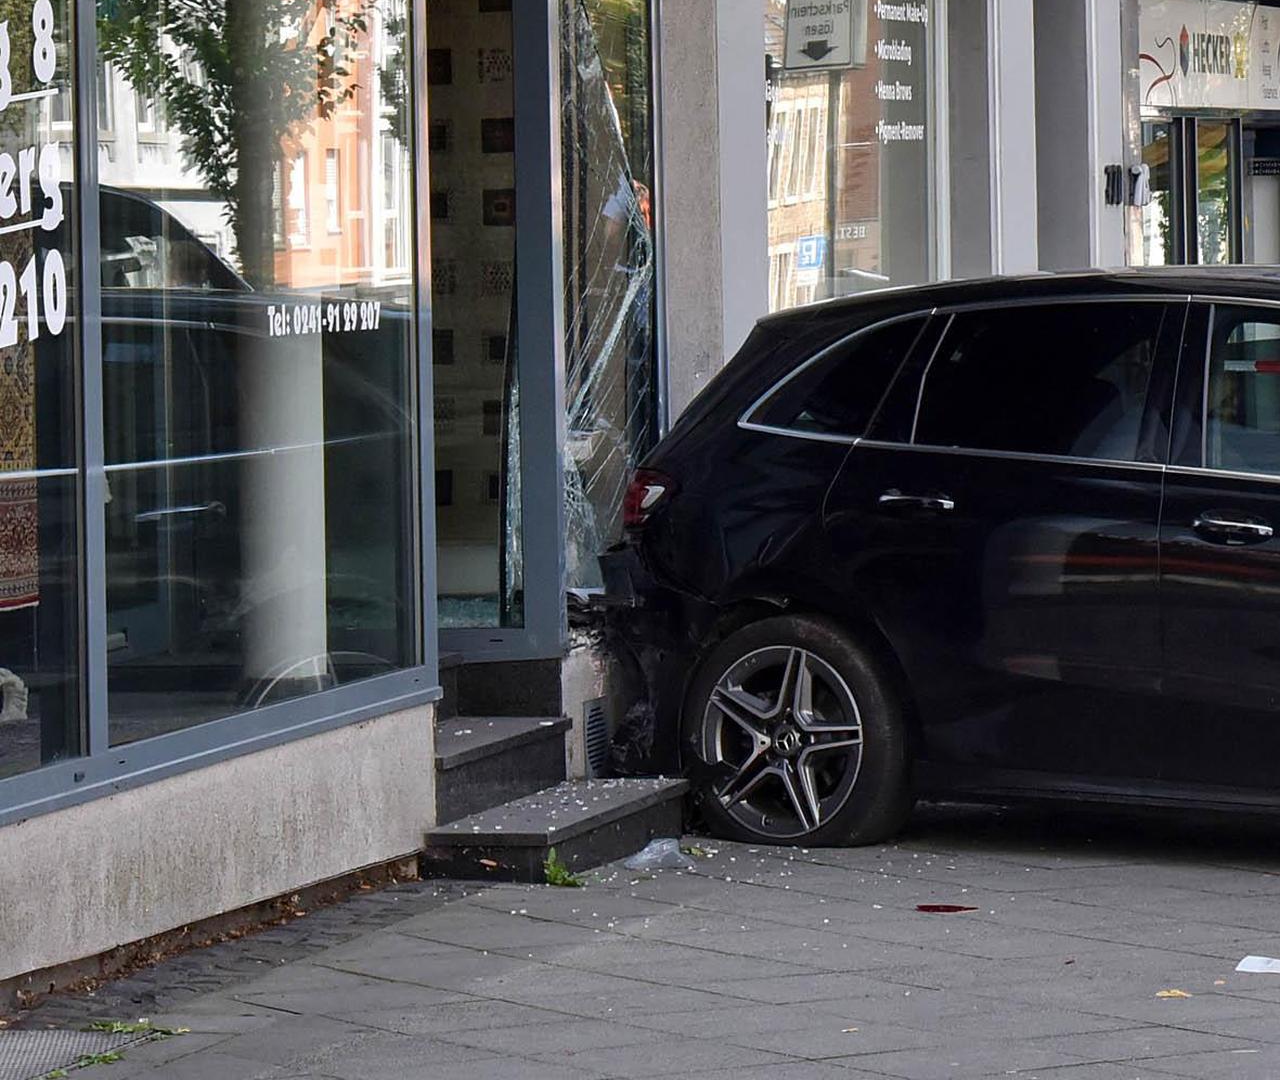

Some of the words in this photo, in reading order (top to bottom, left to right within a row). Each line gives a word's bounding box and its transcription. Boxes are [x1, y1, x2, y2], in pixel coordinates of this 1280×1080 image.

[1192, 32, 1231, 75] HECKER
[267, 304, 291, 336] Tel:
[293, 303, 339, 335] 0241-91
[343, 302, 357, 332] 29
[360, 301, 380, 331] 207
